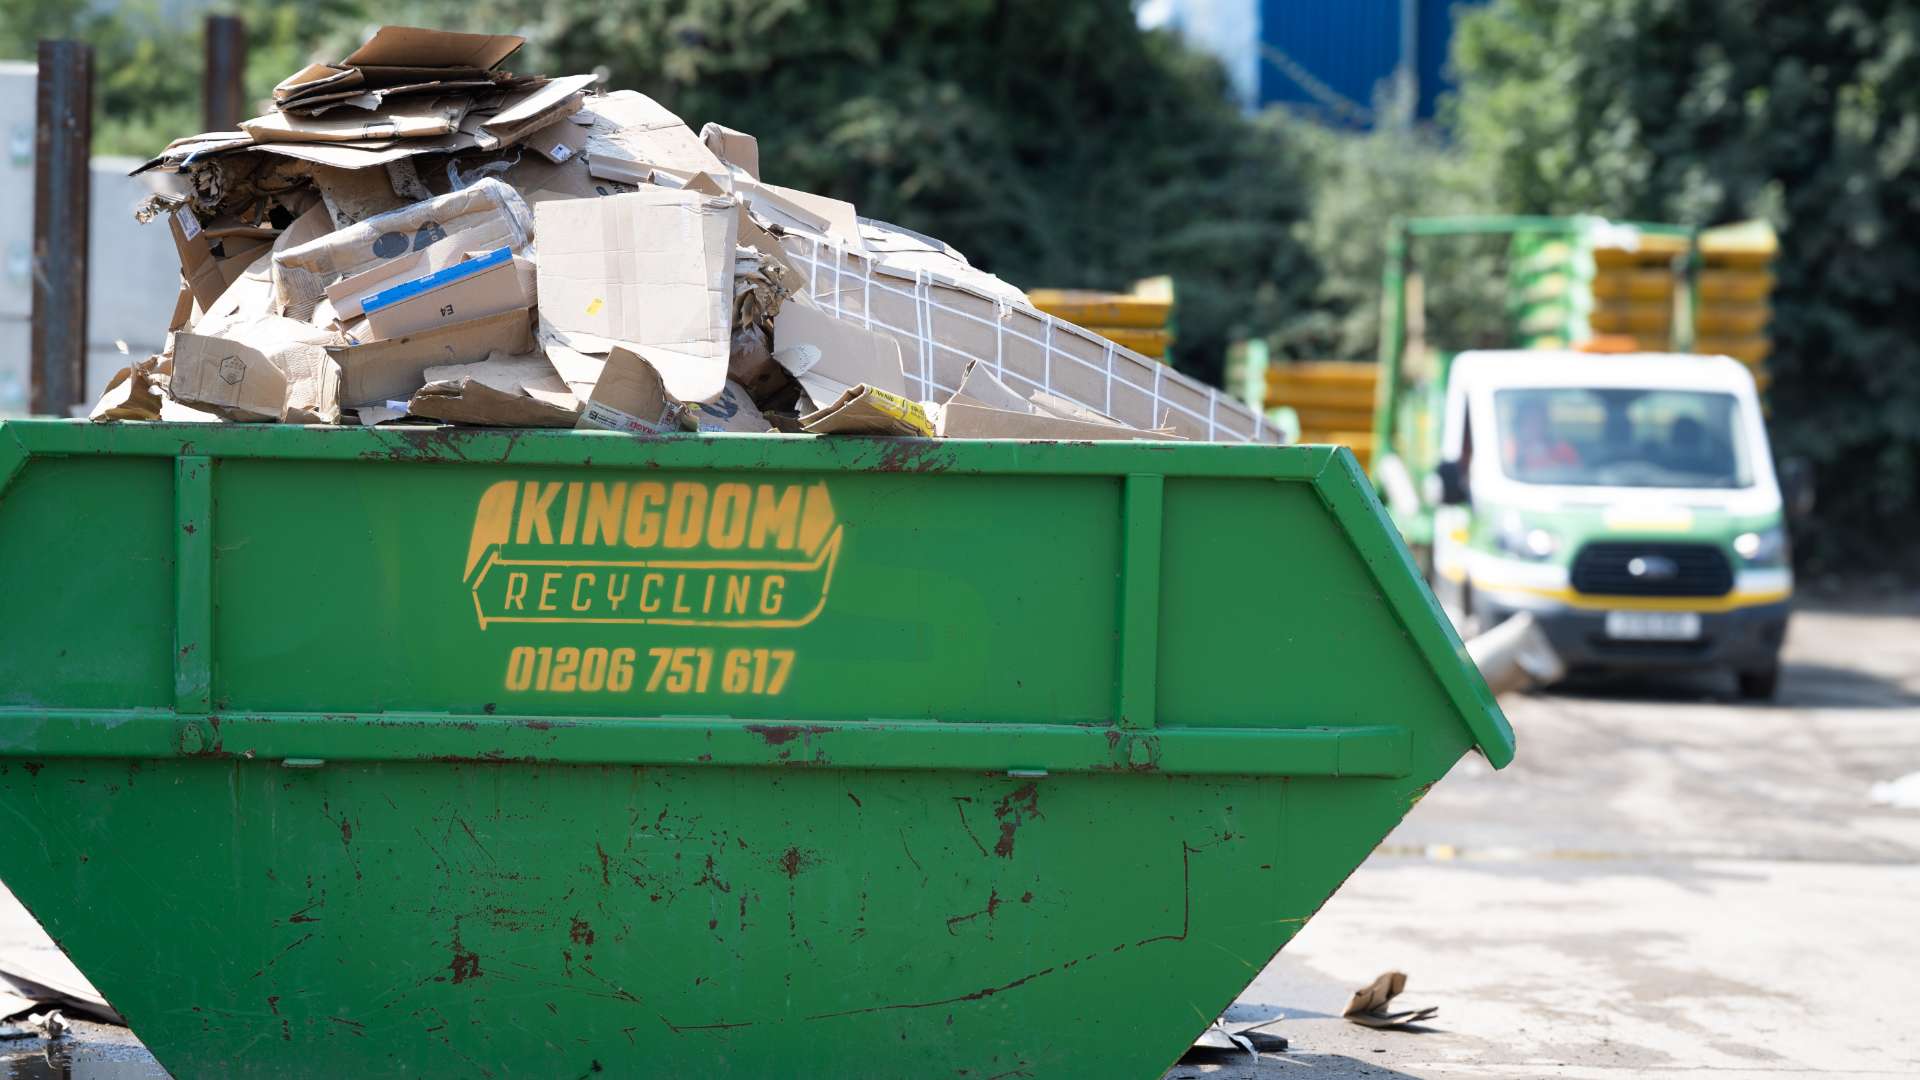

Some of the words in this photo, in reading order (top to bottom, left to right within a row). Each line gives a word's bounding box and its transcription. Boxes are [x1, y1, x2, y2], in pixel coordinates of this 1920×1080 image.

[516, 481, 801, 549] KINGDOM
[505, 573, 785, 615] RECYCLING
[505, 646, 637, 692] 01206
[645, 647, 714, 692] 751
[720, 648, 796, 695] 617
